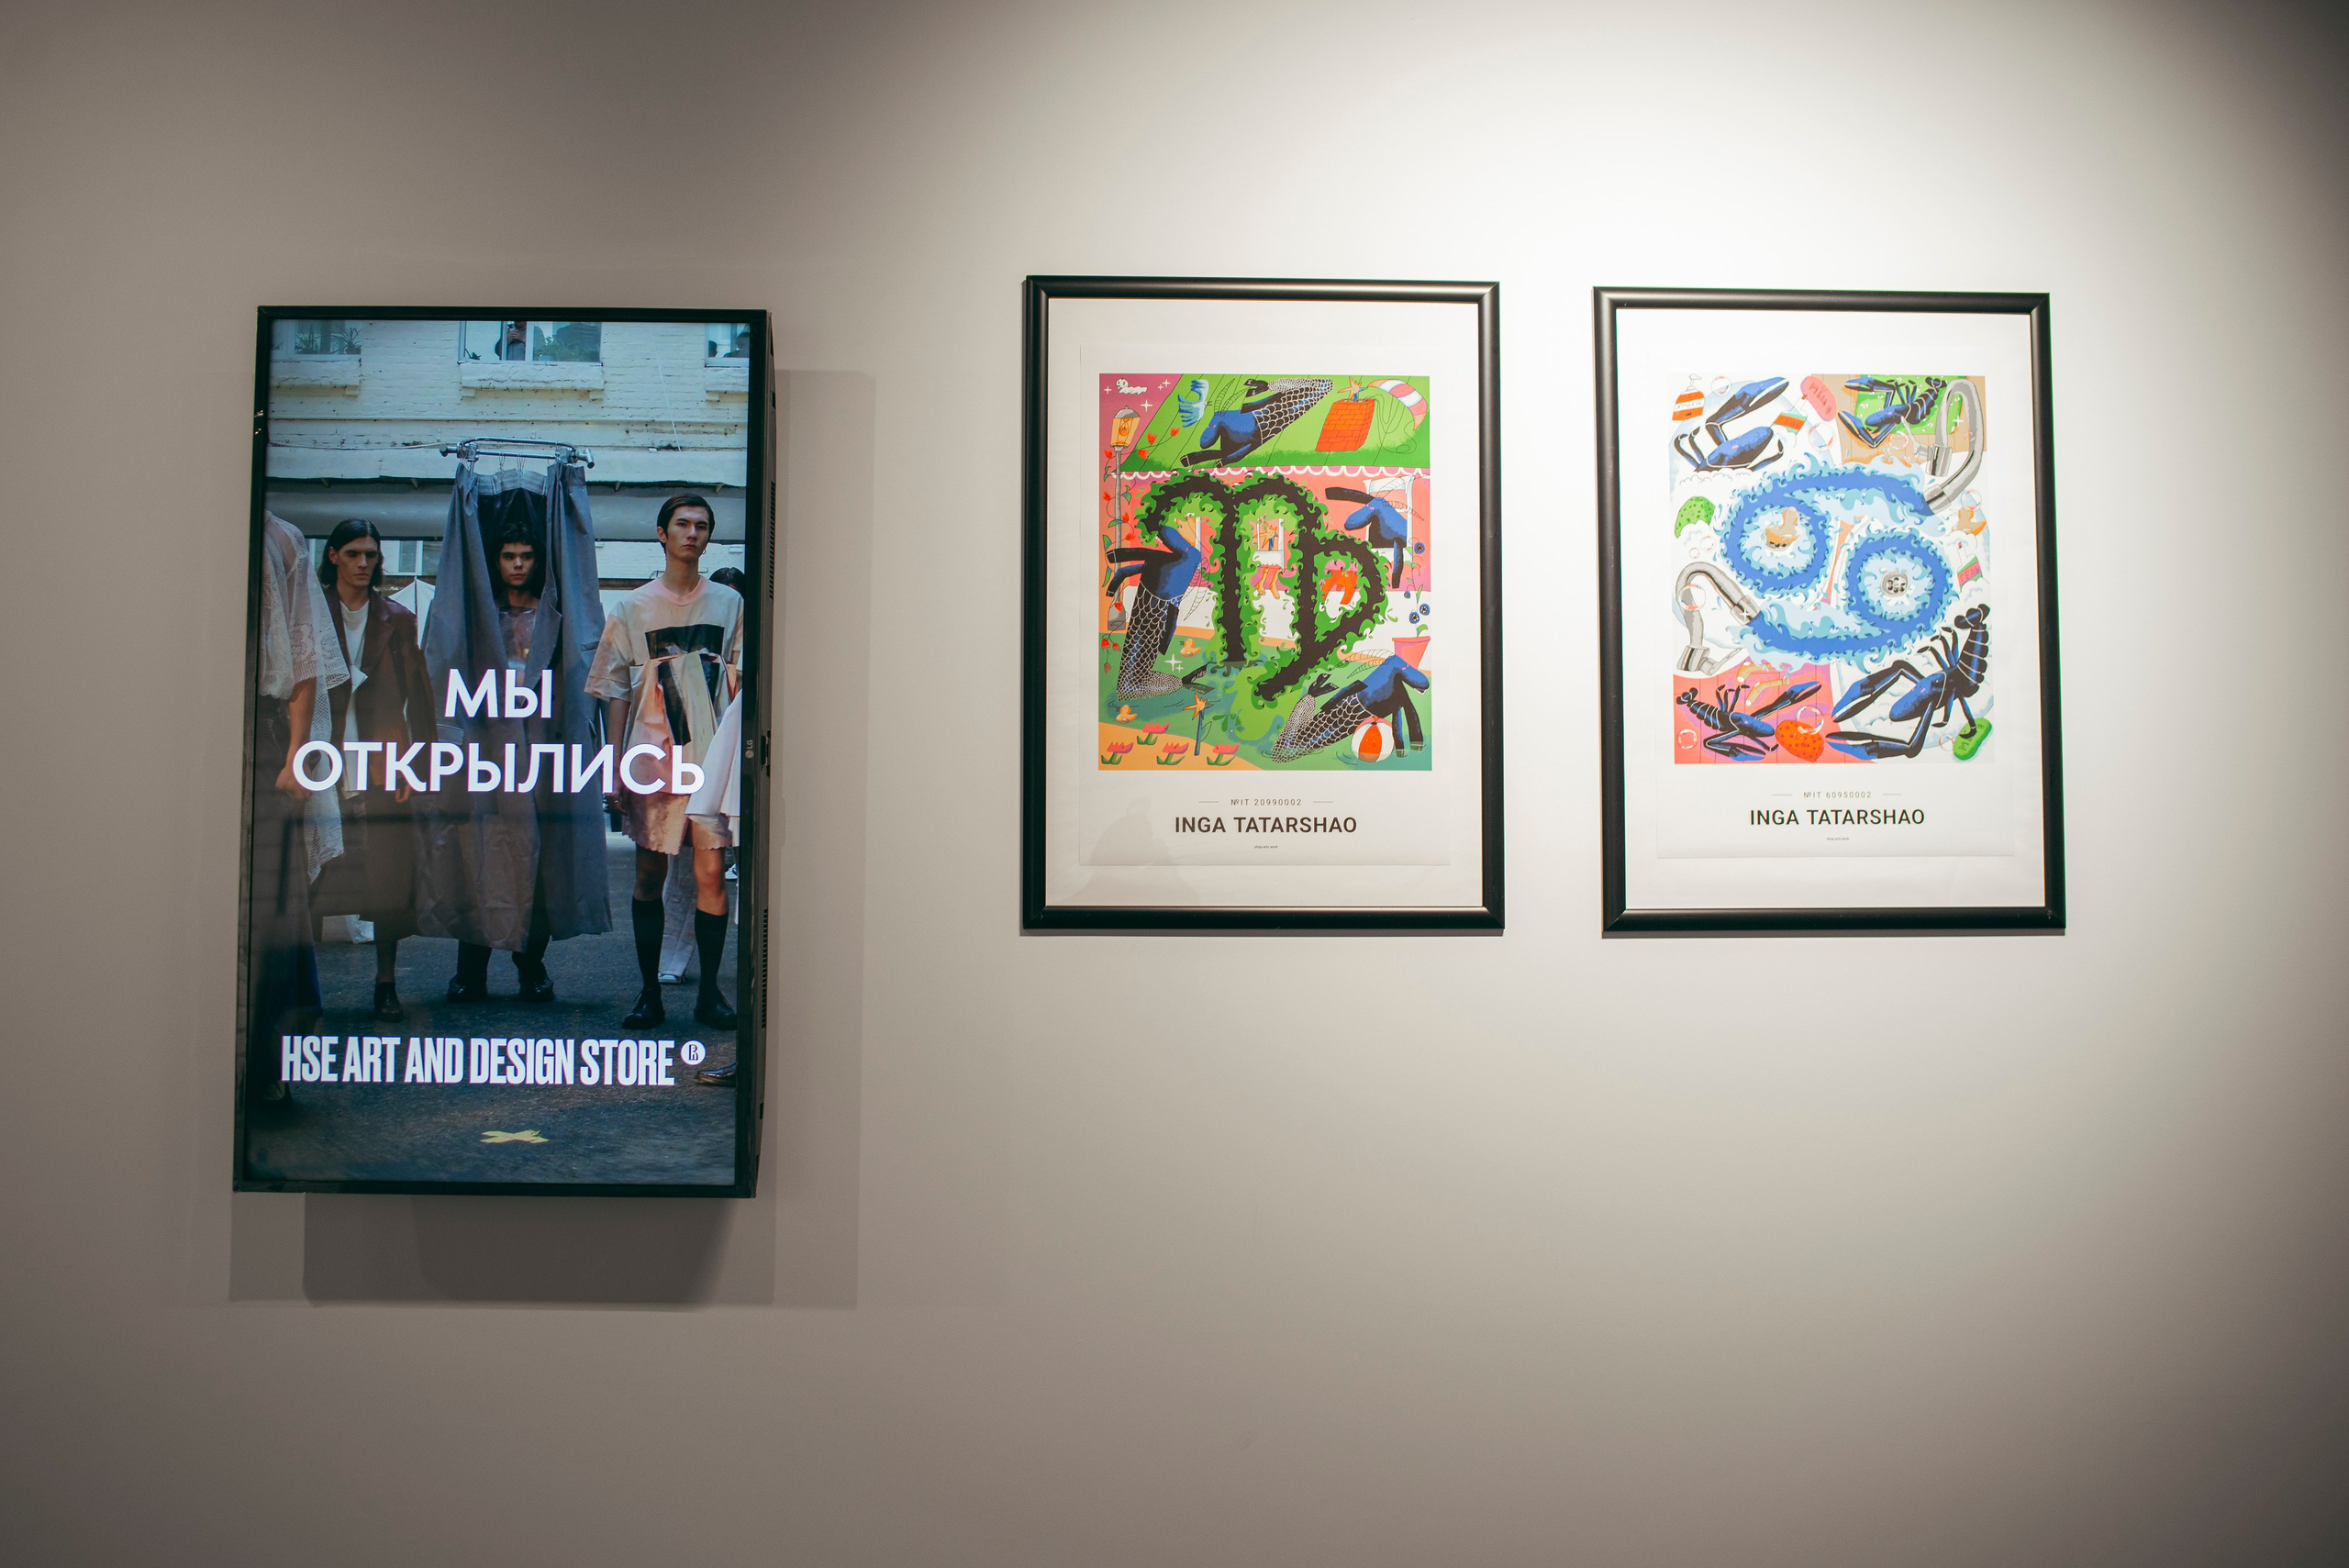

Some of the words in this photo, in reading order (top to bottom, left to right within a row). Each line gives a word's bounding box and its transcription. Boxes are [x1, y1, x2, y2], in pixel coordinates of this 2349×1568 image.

[444, 668, 552, 718] МЫ
[292, 740, 707, 795] ОТКРЫЛИСЬ
[1253, 798, 1302, 806] 20990002
[1825, 791, 1872, 799] 60950002
[1174, 817, 1227, 833] INGA
[1233, 817, 1357, 833] TATARSHAO
[1750, 809, 1799, 826] INGA
[1806, 808, 1926, 826] TATARSHAO
[282, 1035, 339, 1082] HSE
[342, 1036, 401, 1083] ART
[404, 1037, 464, 1084] AND
[469, 1038, 575, 1085] DESIGN
[580, 1039, 675, 1086] STORE
